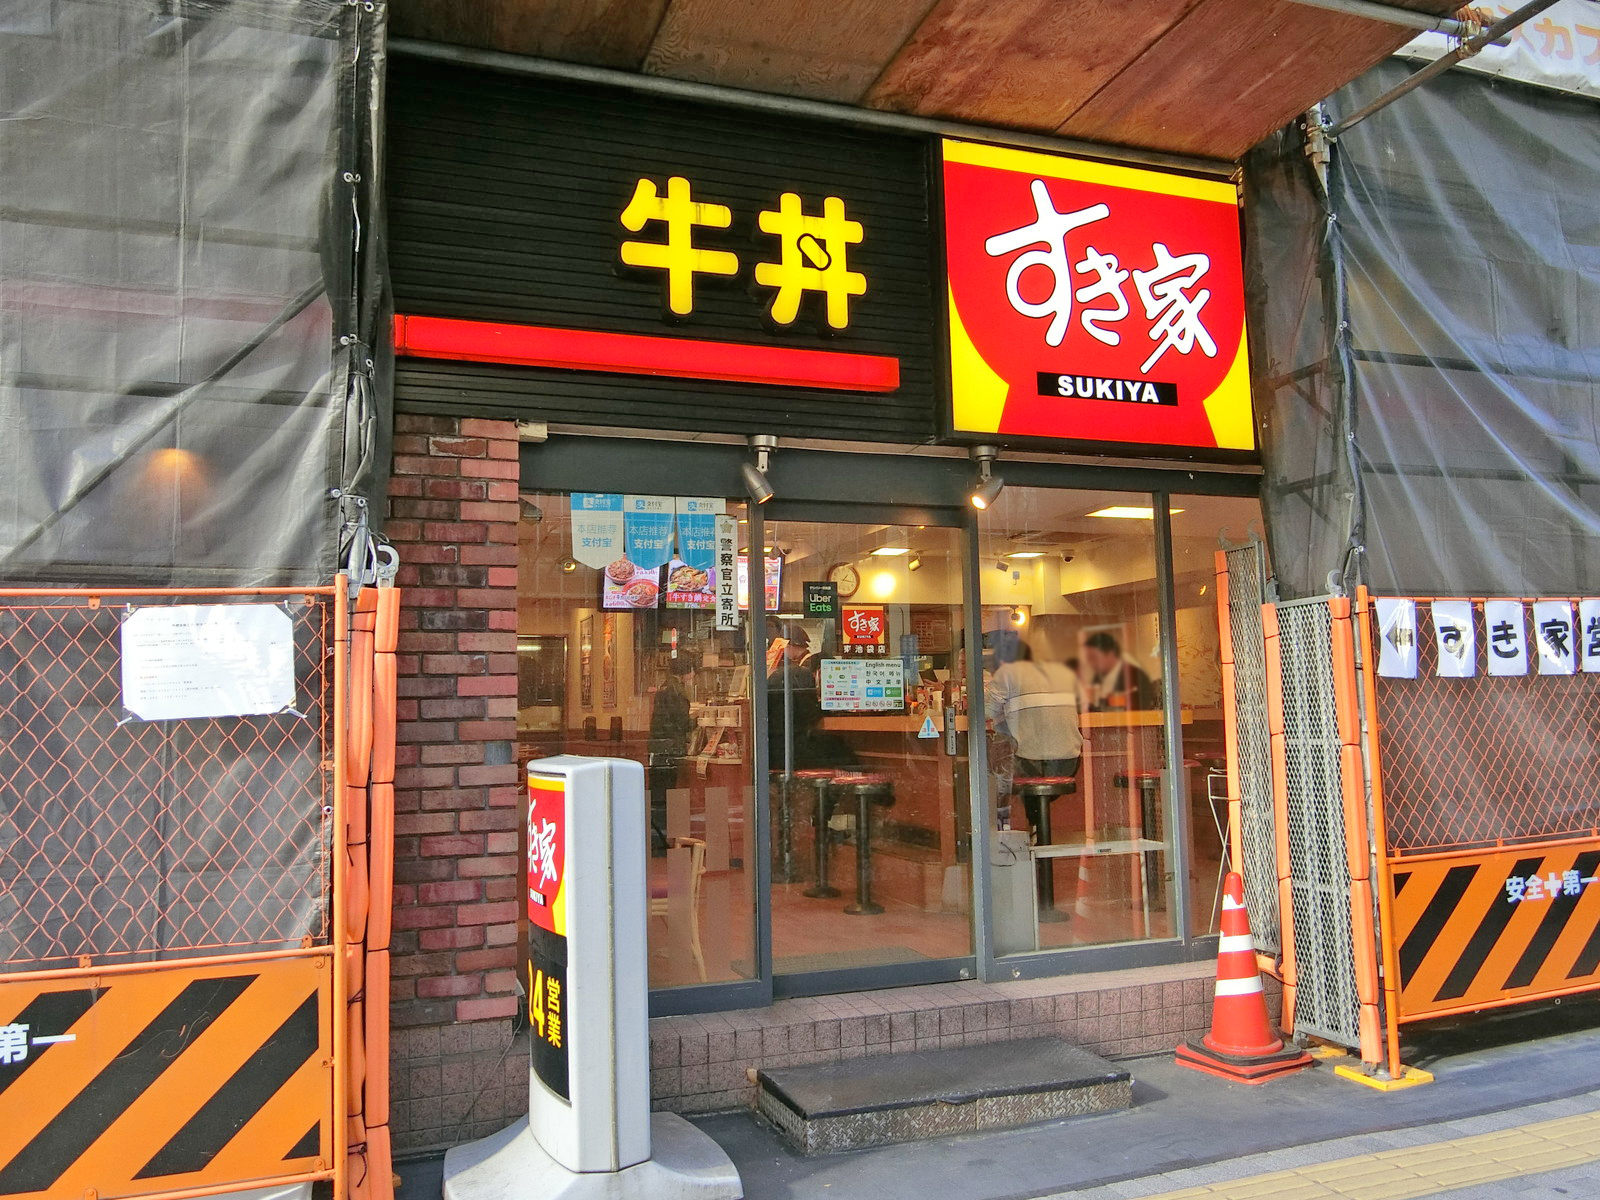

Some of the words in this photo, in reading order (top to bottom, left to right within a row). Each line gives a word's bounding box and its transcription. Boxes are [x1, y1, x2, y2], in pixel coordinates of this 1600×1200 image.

[620, 176, 867, 329] 牛丼
[985, 179, 1218, 374] すき家
[1057, 375, 1159, 403] SUKIYA
[577, 524, 617, 535] 本店推荐
[629, 525, 669, 537] 本店推荐
[582, 537, 612, 548] 支付宝
[634, 539, 664, 550] 支付宝
[687, 539, 715, 550] 支付宝
[720, 538, 733, 626] 警察官立寄所
[810, 594, 831, 602] Uber
[810, 603, 832, 611] Eats
[847, 610, 880, 634] すき家
[843, 645, 886, 654] 東池袋店
[547, 976, 562, 1049] 営業
[0, 1023, 76, 1064] 第一
